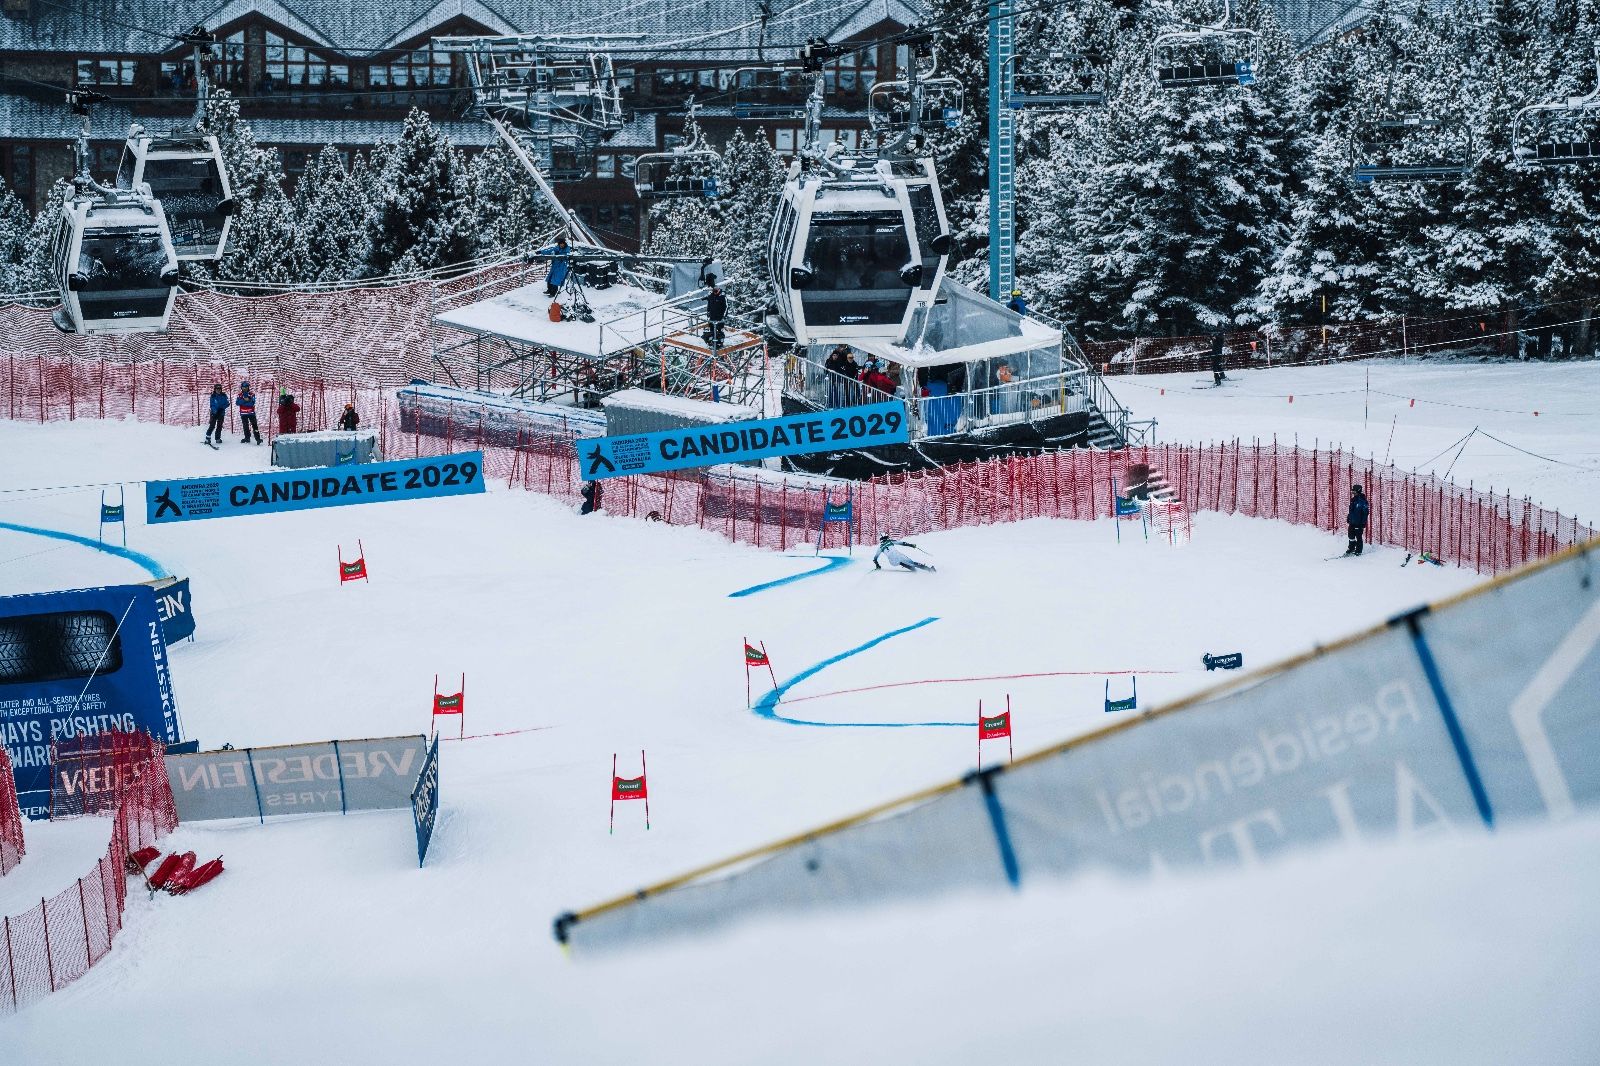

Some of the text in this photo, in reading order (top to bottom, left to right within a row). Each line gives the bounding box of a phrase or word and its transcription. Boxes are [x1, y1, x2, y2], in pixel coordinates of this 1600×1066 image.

[659, 411, 902, 461] CANDIDATE 2029
[229, 461, 478, 508] CANDIDATE 2029
[10, 705, 54, 717] EXCEPTIONAL
[56, 703, 73, 713] GRIP
[82, 701, 107, 711] SAFETY
[22, 698, 35, 708] AND
[50, 712, 136, 741] PUSHING
